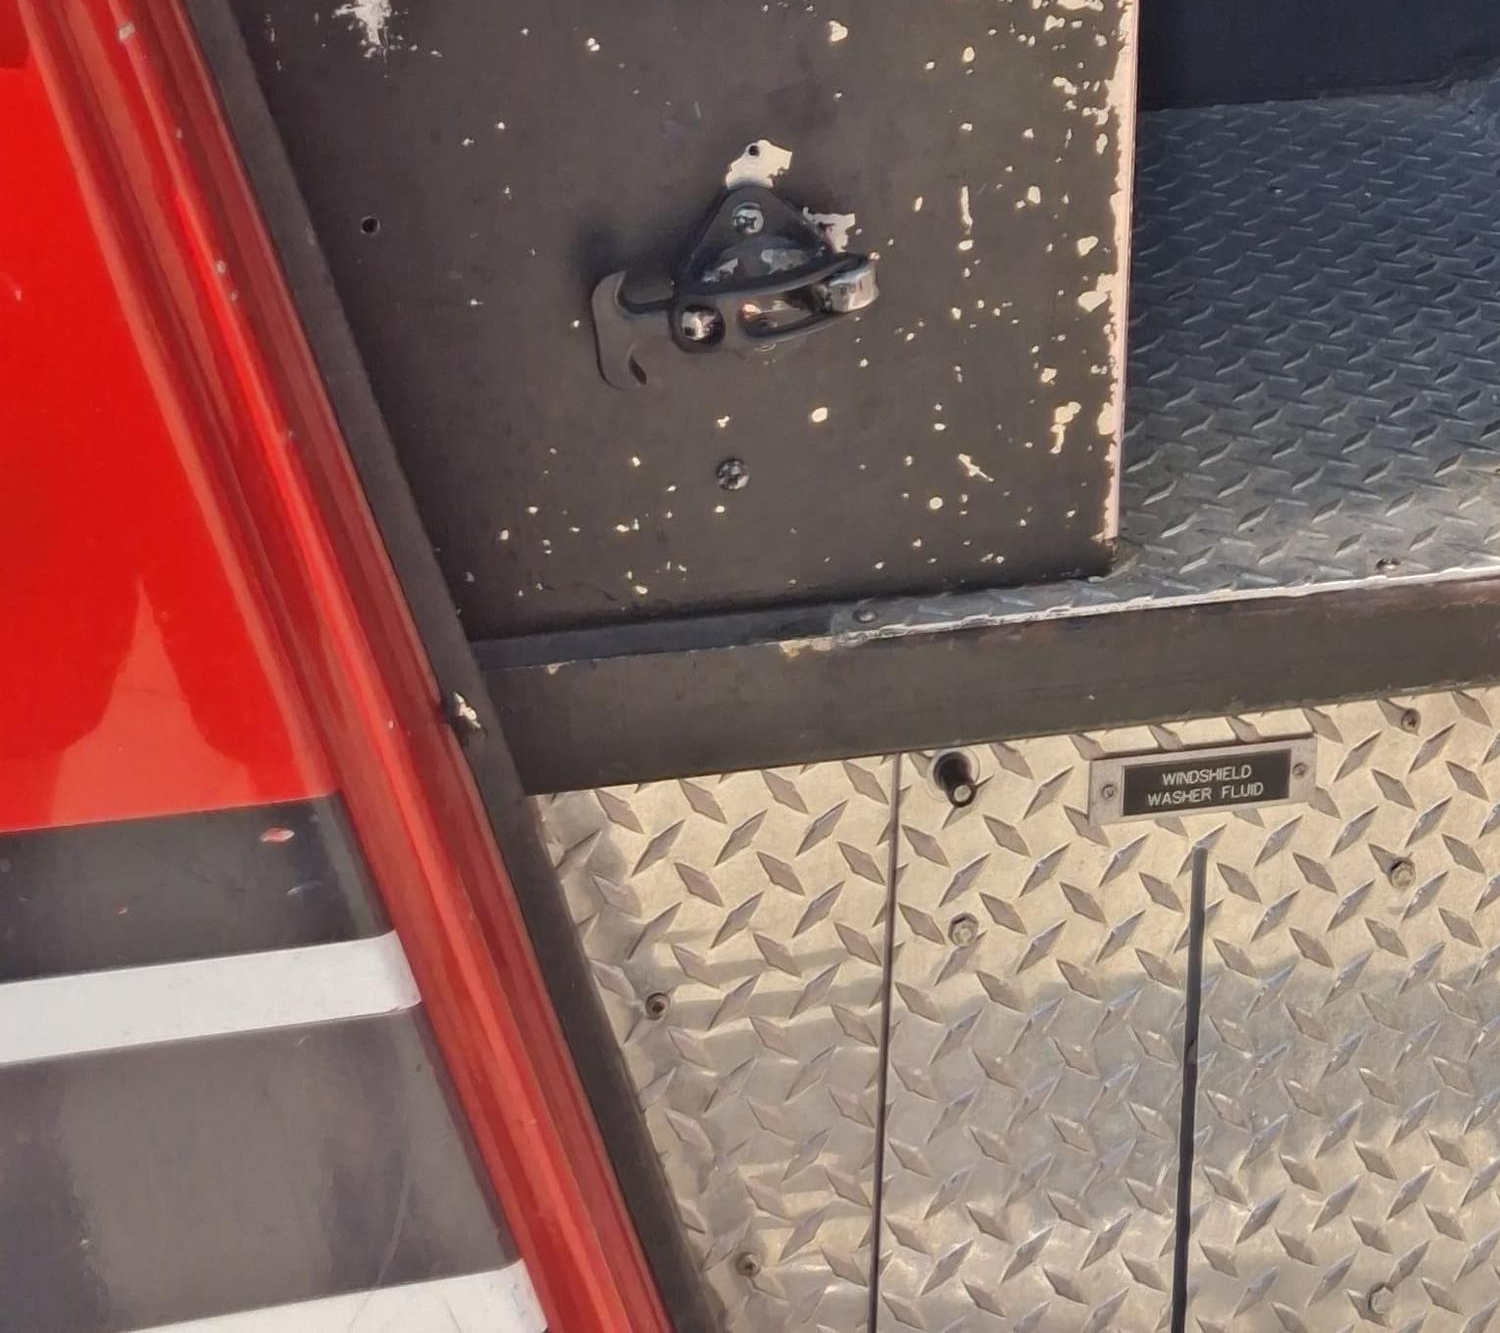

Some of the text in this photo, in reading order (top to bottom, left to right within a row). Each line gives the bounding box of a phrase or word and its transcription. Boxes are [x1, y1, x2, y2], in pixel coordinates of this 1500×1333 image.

[1162, 764, 1252, 787] WINDSHIELD
[1147, 782, 1264, 807] WASHER FLUID
